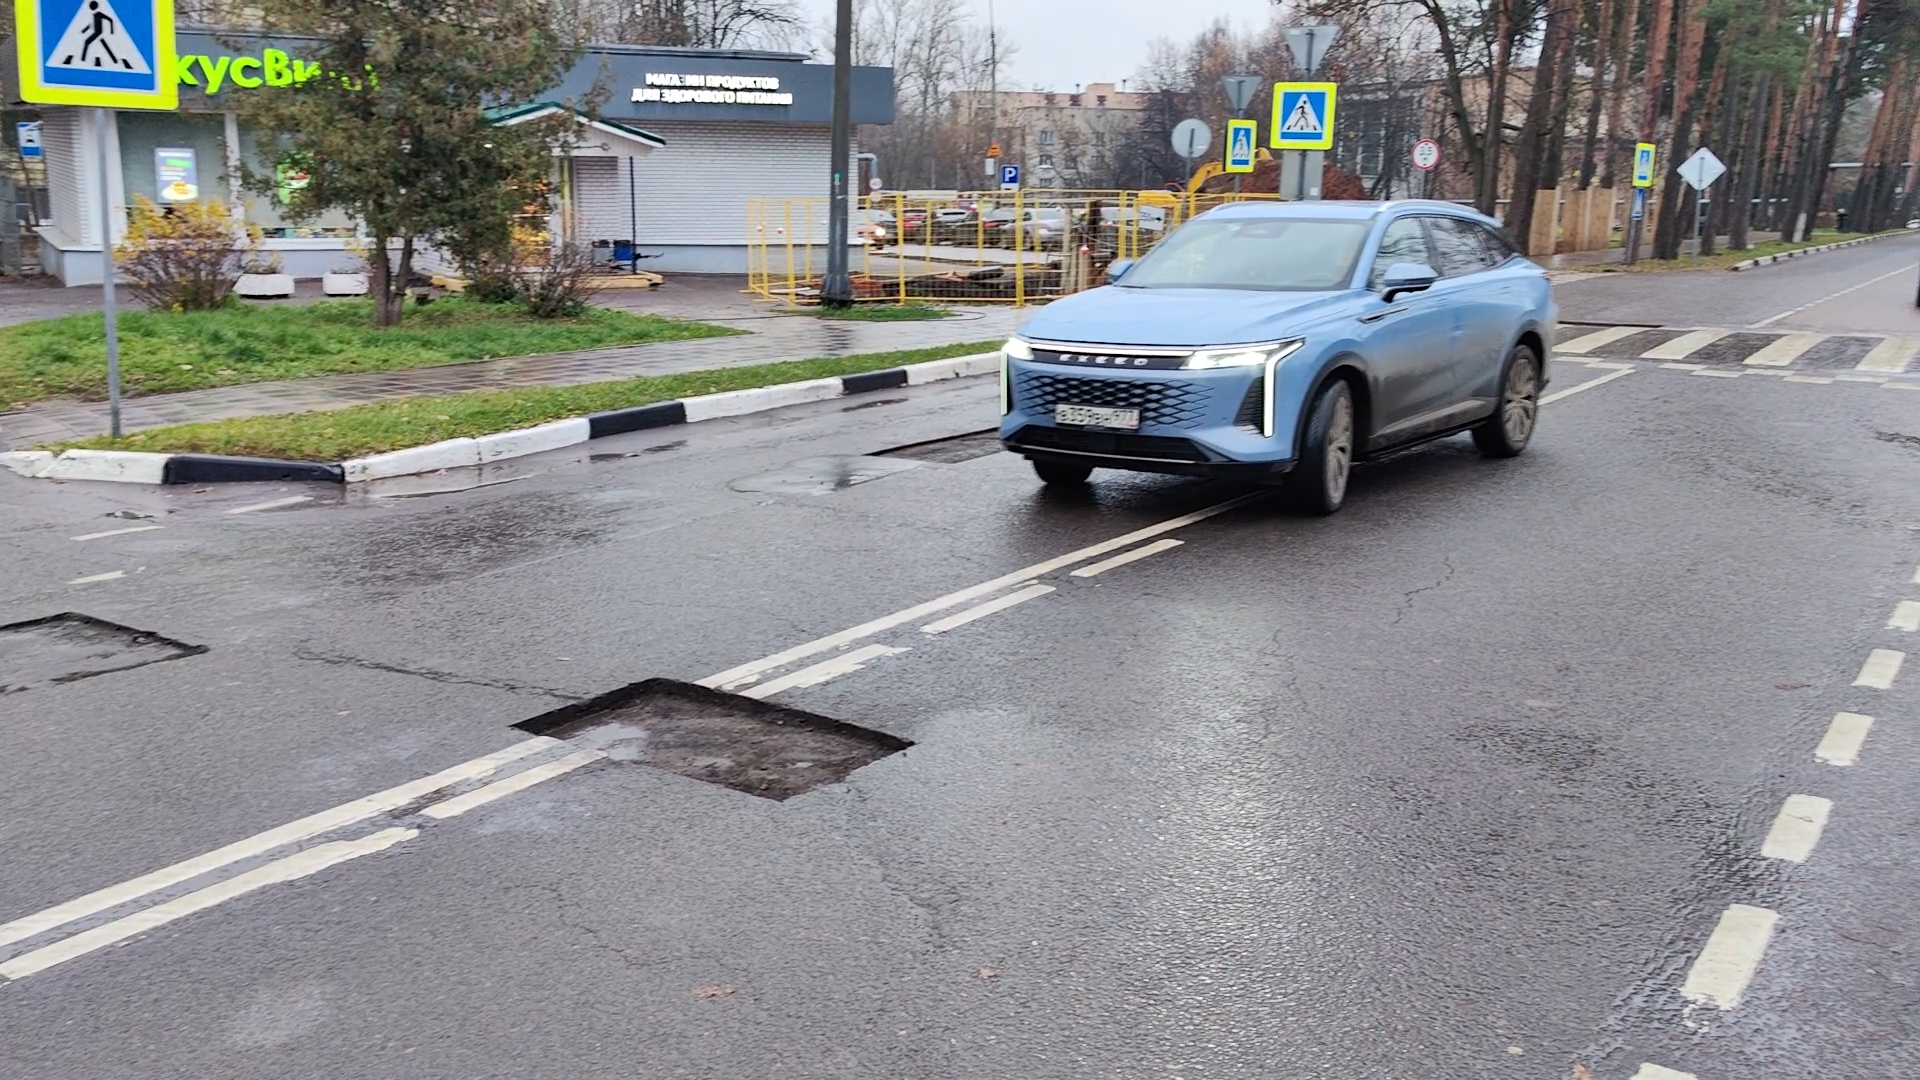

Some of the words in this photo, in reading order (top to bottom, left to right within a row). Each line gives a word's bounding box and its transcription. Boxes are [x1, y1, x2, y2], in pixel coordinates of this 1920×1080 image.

[645, 73, 705, 87] МАГАЗИН
[705, 75, 779, 90] ПРОДУКТОВ
[631, 88, 660, 102] ДЛЯ
[661, 88, 736, 104] ЗДОРОВОГО
[736, 91, 793, 105] ПИТАНИЯ
[1004, 167, 1017, 182] P
